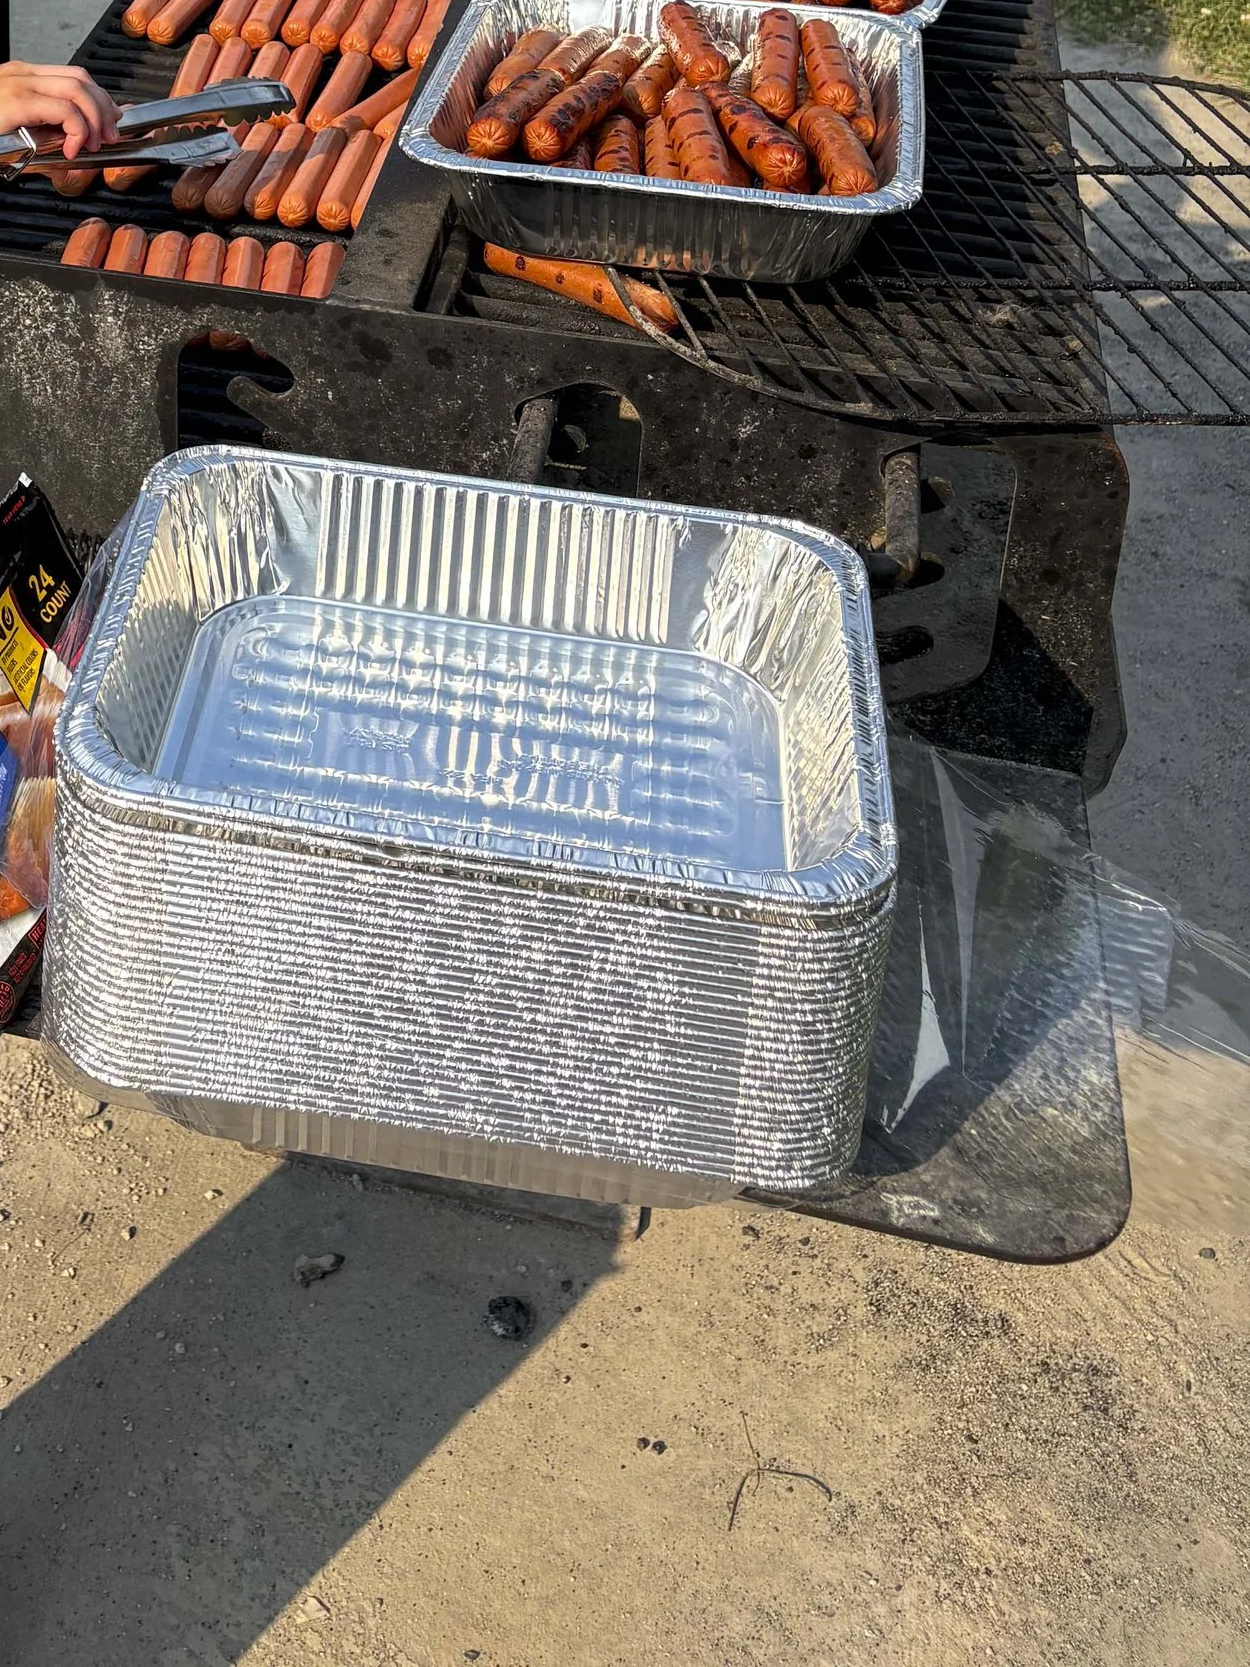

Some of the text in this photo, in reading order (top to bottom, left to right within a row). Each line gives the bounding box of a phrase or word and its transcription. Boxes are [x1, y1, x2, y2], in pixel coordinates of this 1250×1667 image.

[28, 564, 56, 602] 24
[39, 580, 72, 623] COUNT
[13, 649, 39, 685] ARTIFICIAL COLORS
[21, 667, 36, 687] FLAVORS
